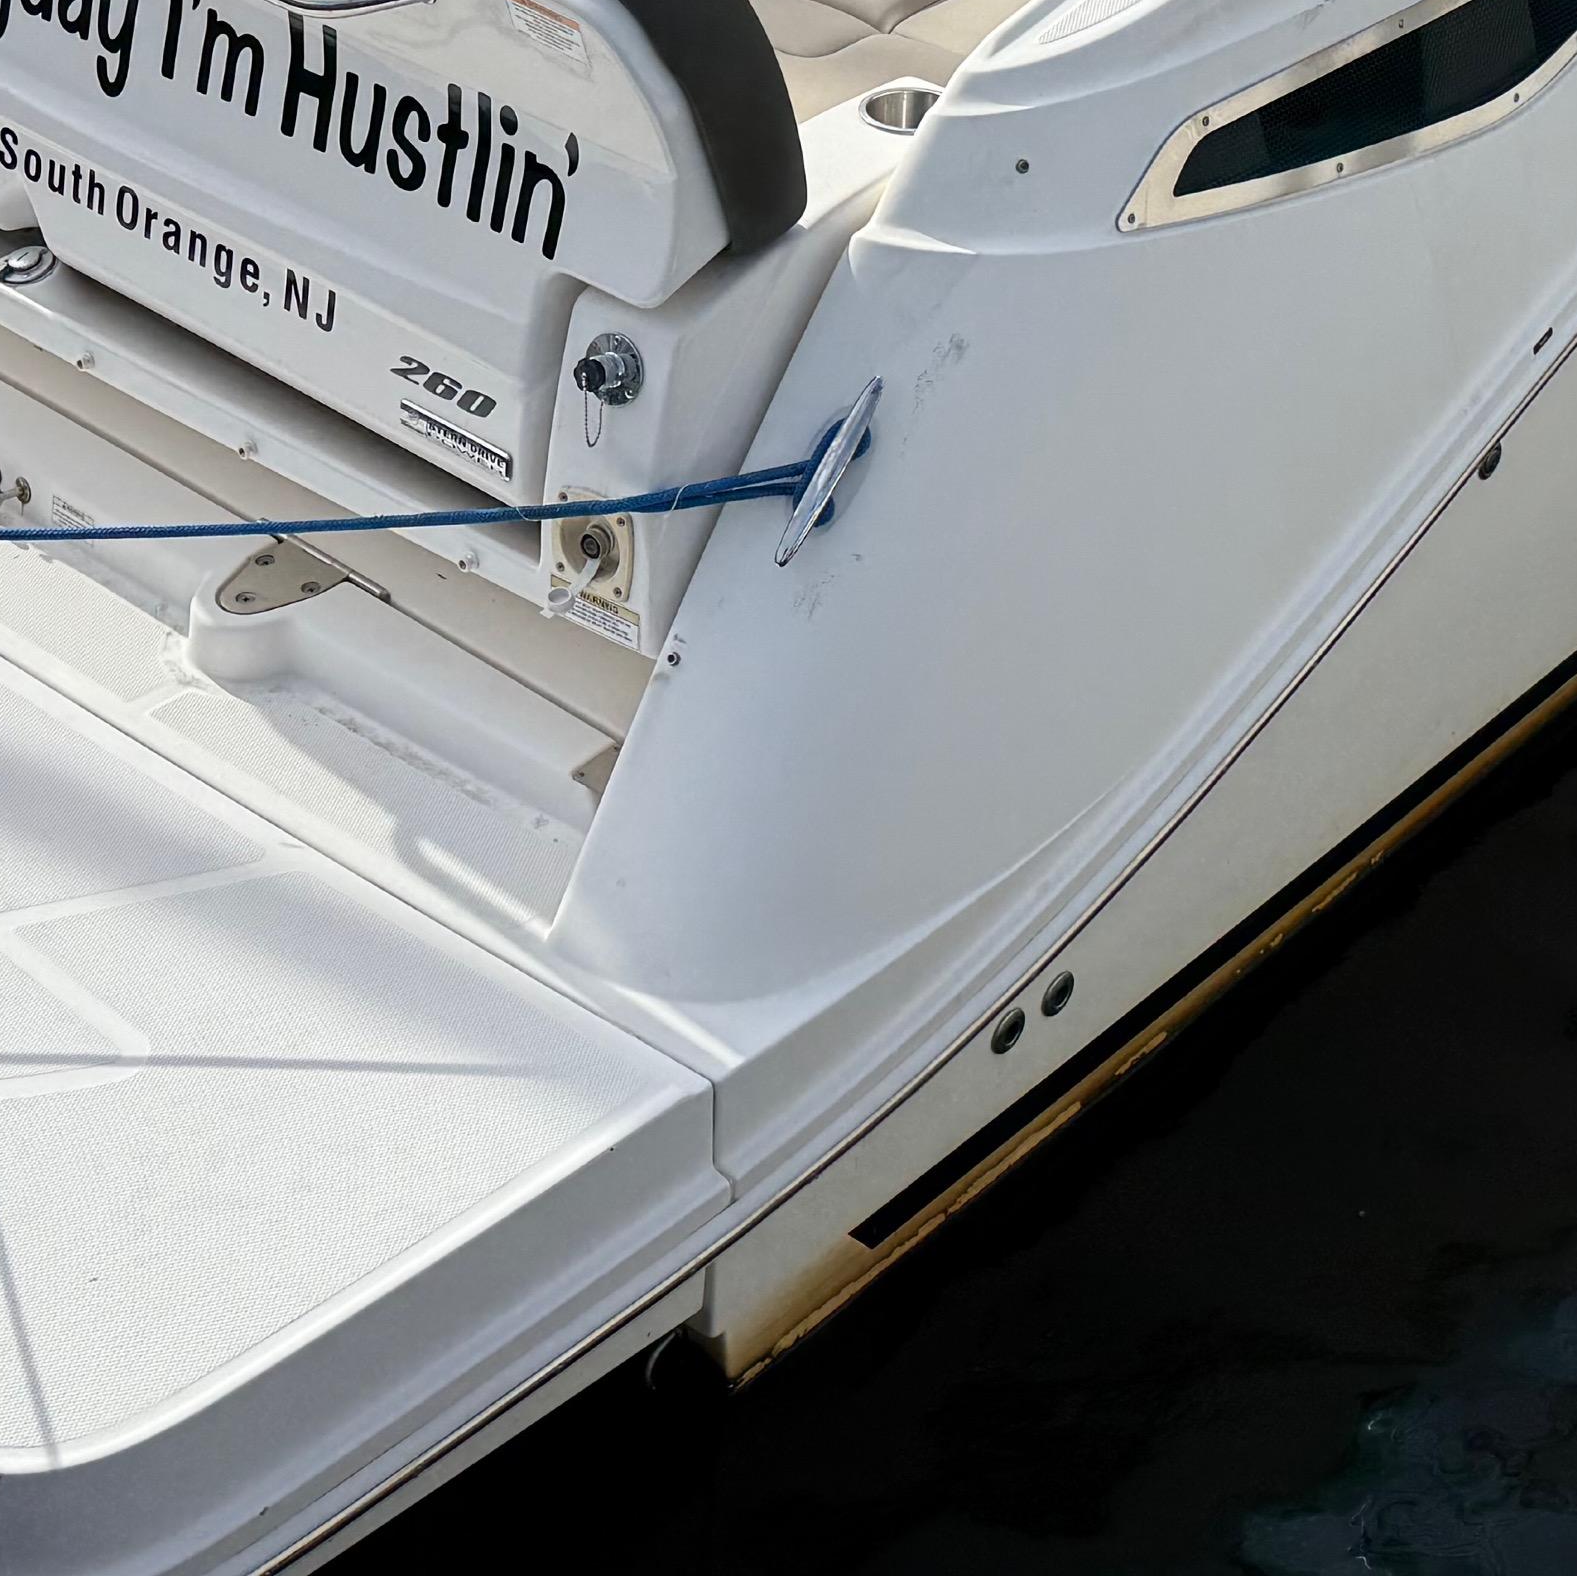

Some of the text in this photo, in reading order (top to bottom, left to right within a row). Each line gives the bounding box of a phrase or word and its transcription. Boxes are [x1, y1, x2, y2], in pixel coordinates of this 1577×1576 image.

[280, 10, 580, 261] Hustlin'
[116, 185, 271, 308] Orange,
[283, 268, 337, 333] NJ
[389, 355, 497, 418] 260
